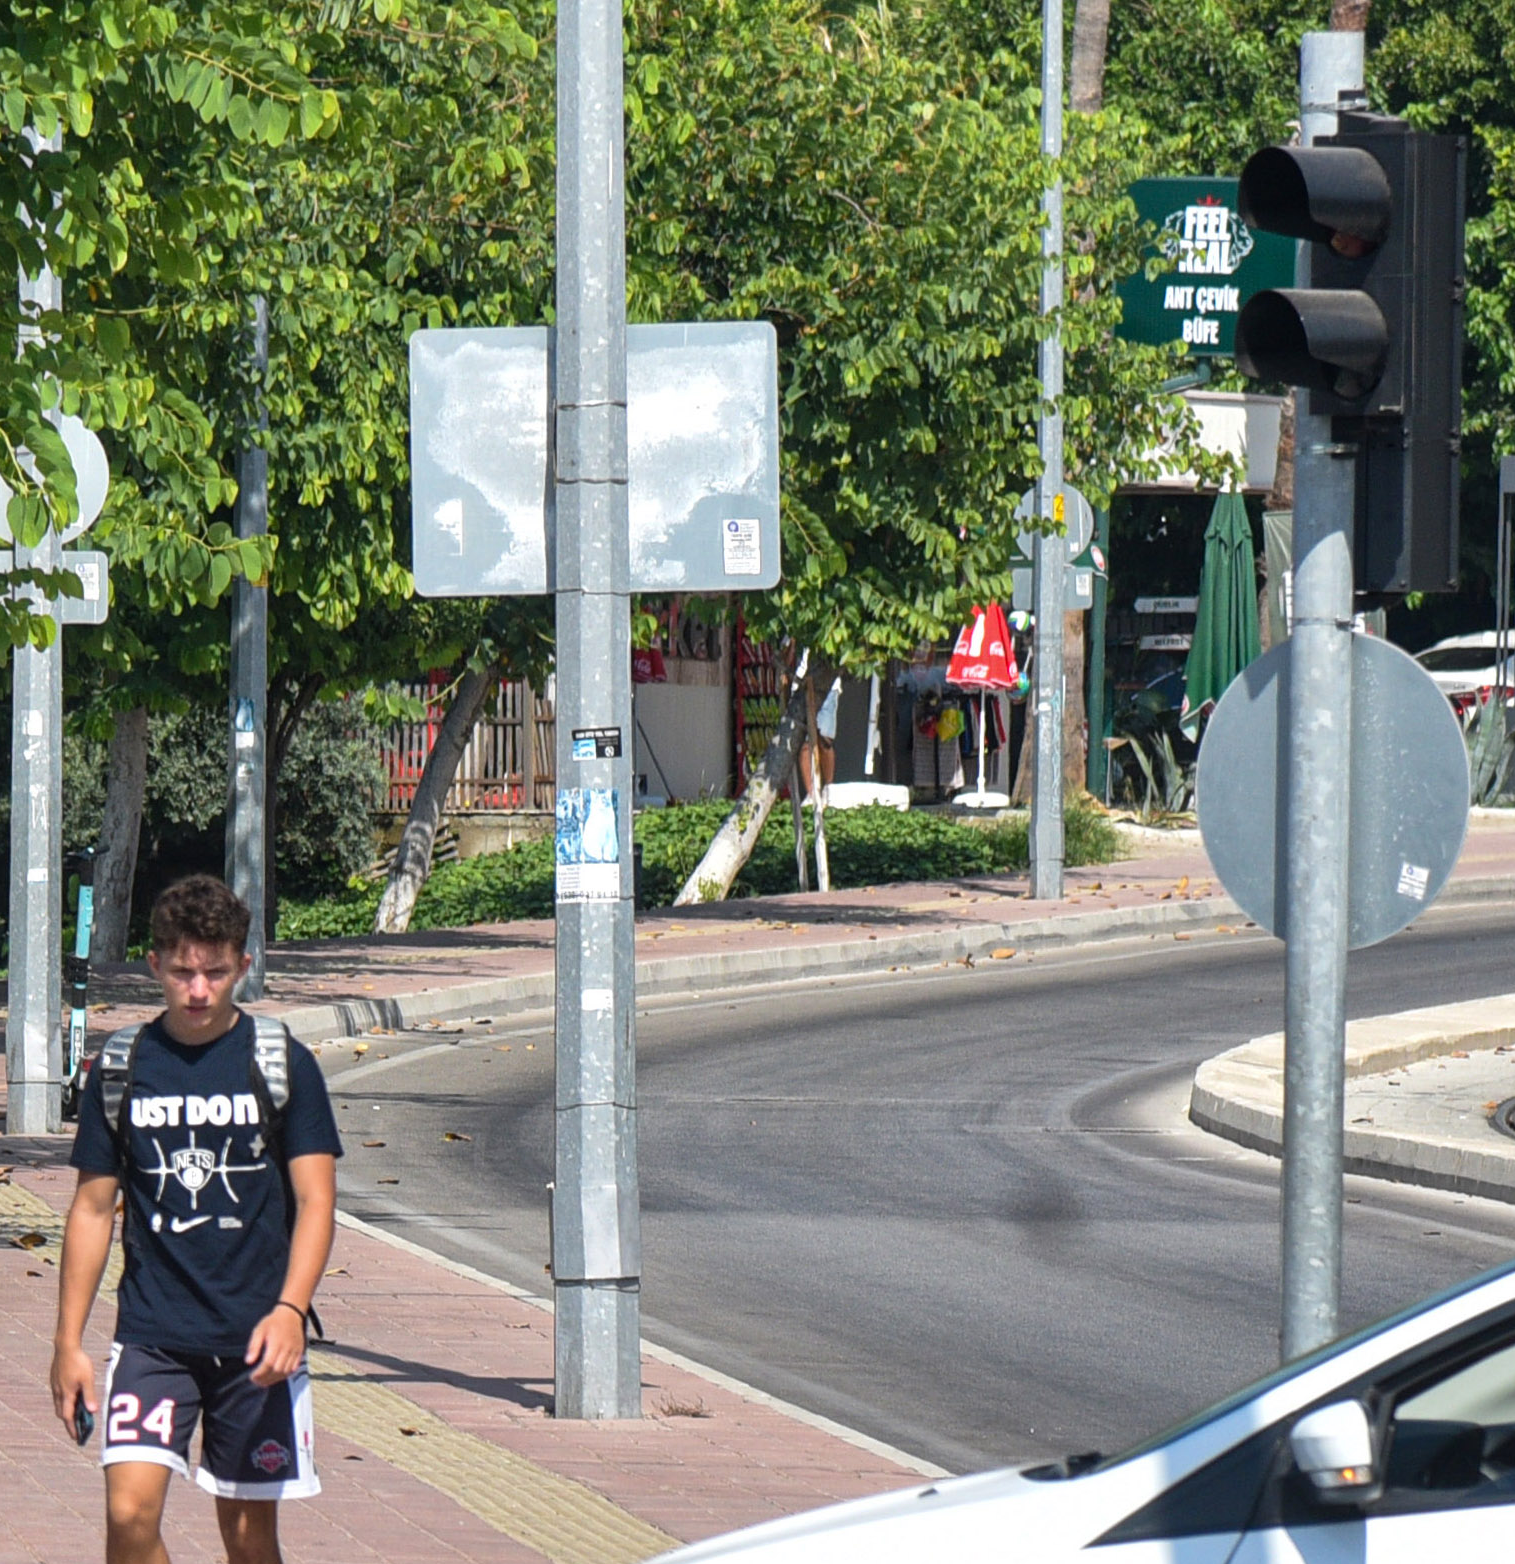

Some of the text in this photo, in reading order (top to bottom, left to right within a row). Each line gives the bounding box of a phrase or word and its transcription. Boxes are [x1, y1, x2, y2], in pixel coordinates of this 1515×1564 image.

[1184, 206, 1231, 241] FEEL
[1164, 284, 1240, 315] ANT ÇEVİK
[1182, 316, 1220, 345] BÜFE
[130, 1095, 184, 1129] UST
[185, 1093, 233, 1127] DO
[176, 1153, 212, 1170] NETS
[108, 1391, 175, 1446] 24
